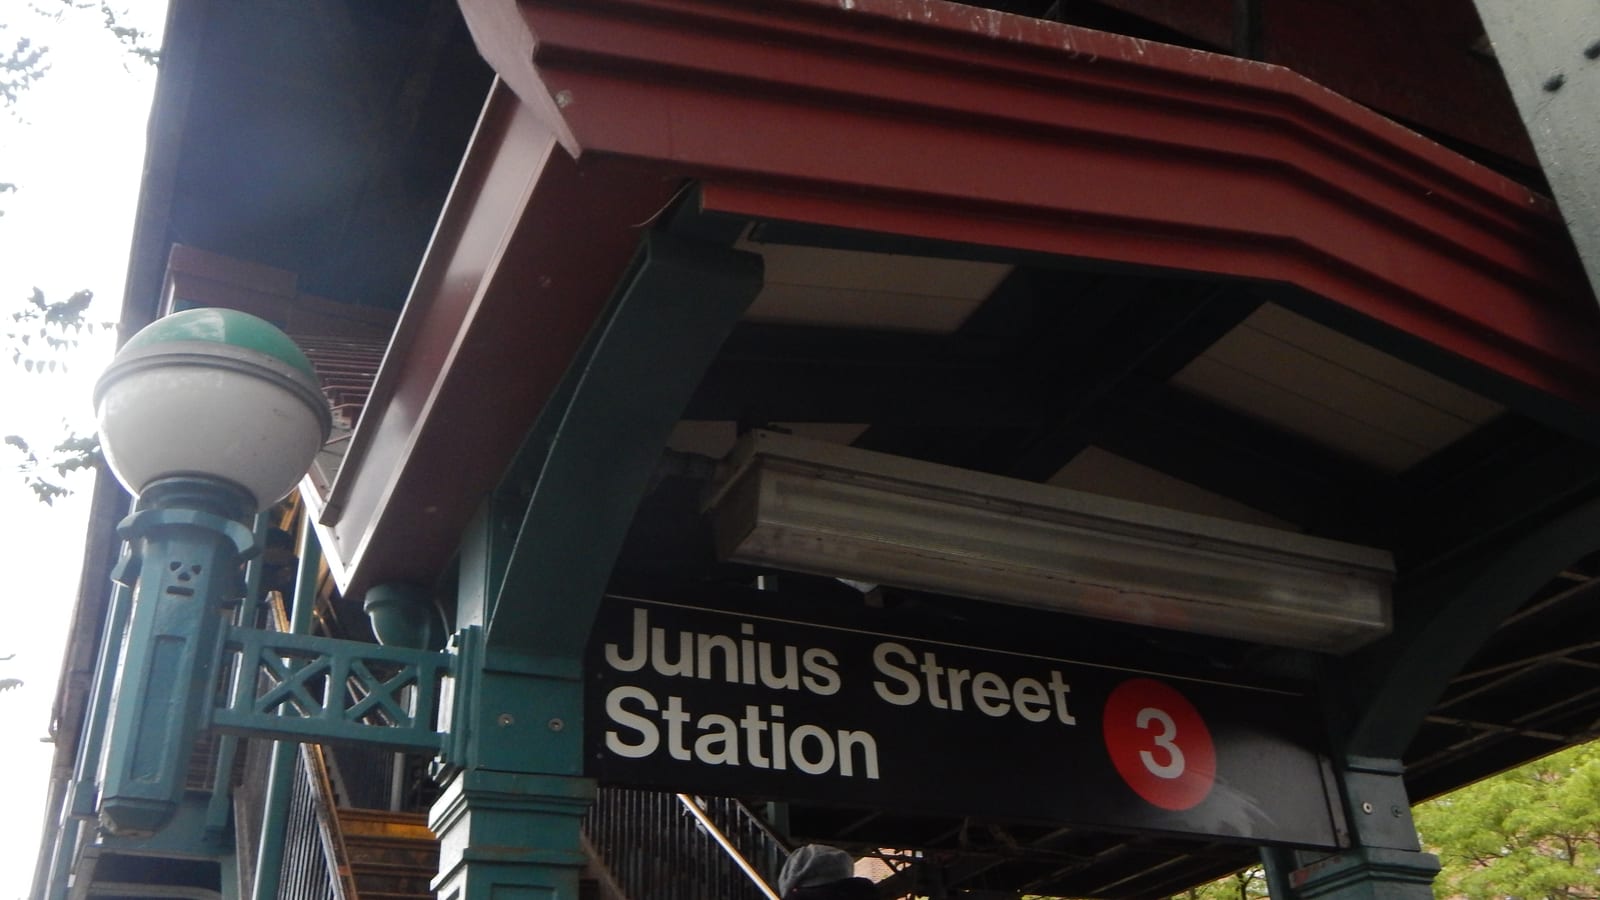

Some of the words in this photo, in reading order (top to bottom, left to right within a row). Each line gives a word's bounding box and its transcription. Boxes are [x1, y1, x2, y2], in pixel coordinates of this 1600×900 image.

[605, 608, 841, 696] Junius
[872, 642, 1077, 727] Street
[605, 686, 879, 780] Station
[1136, 707, 1186, 779] 3
